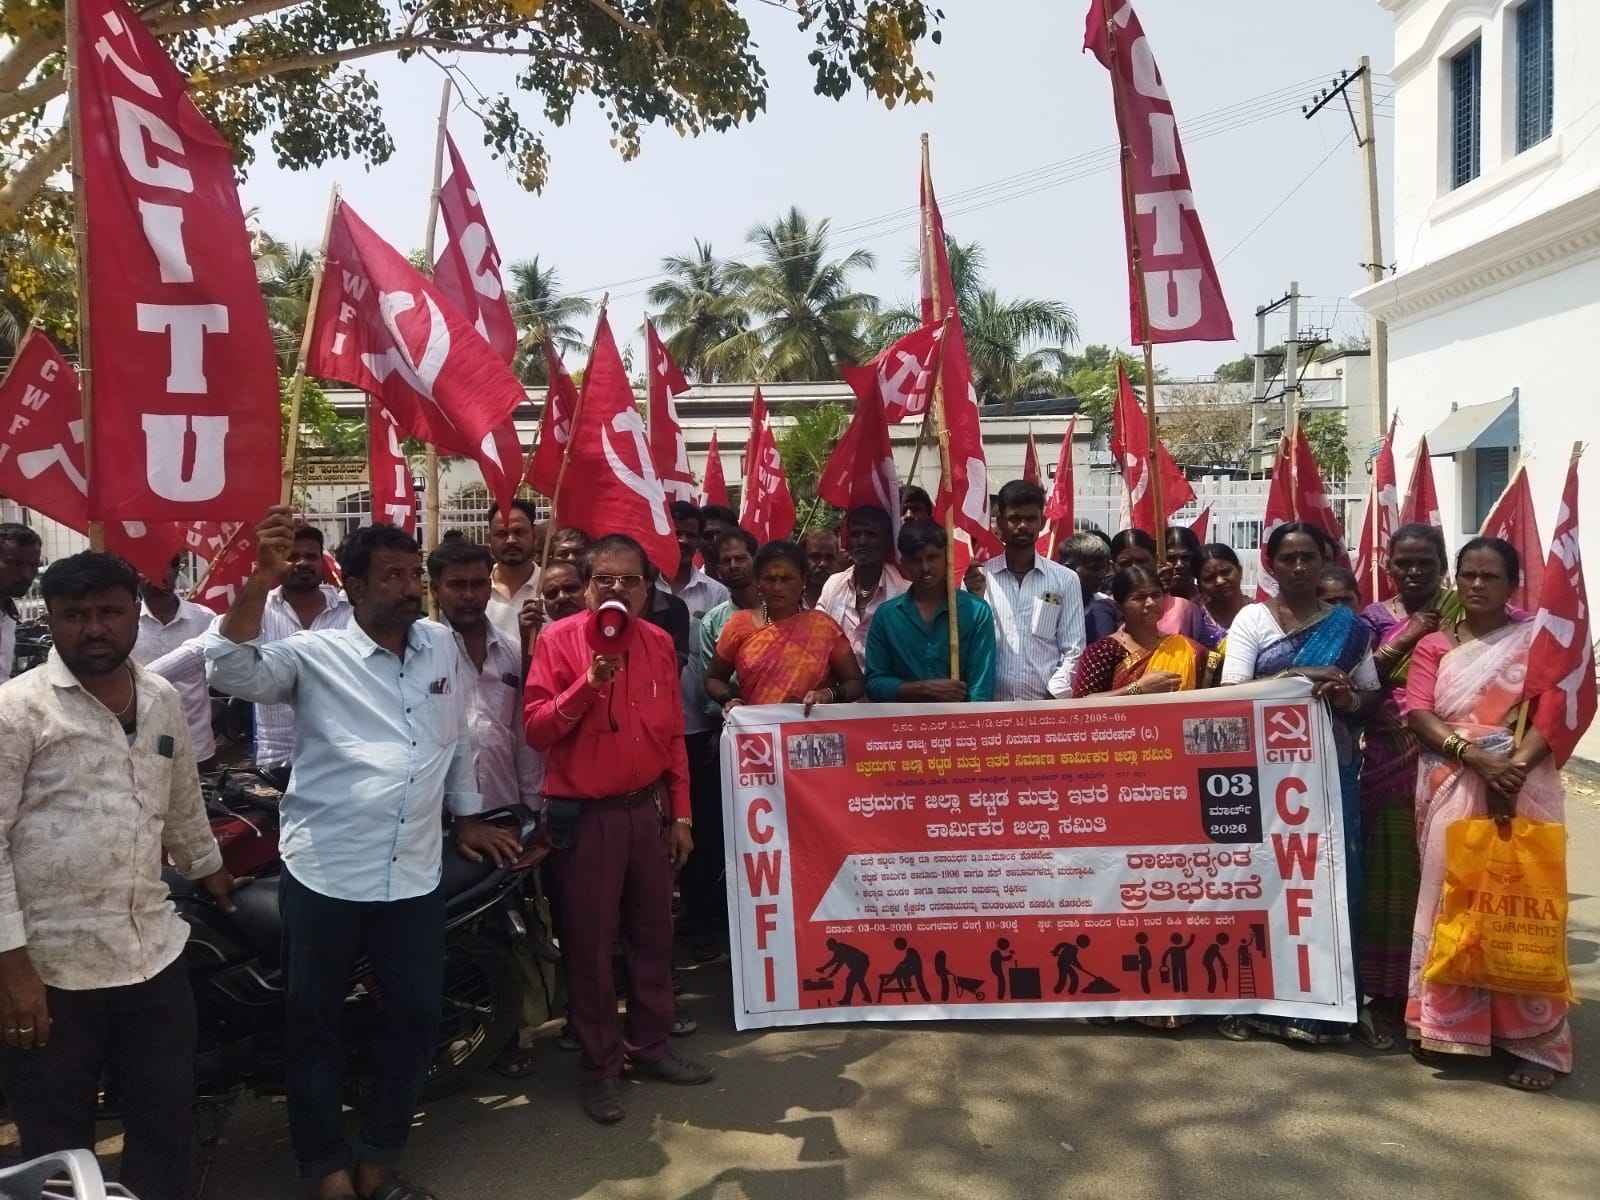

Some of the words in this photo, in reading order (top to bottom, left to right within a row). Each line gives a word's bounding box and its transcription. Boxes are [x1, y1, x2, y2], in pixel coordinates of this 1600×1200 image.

[111, 95, 230, 503] CITU
[331, 244, 370, 355] WFI
[866, 739, 903, 751] ಕರ್ನಾಟಕ
[907, 739, 928, 754] ರಾಜ್ಯ
[930, 736, 952, 754] ಕಟ್ಟಡ
[955, 736, 977, 750] ಮತ್ತು
[980, 733, 1002, 746] ಇತರೆ
[1006, 732, 1041, 745] ನಿರ್ಮಾಣ
[1045, 730, 1087, 743] ಕಾರ್ಮಿಕರ
[856, 759, 897, 777] ಚಿತ್ರದುರ್ಗ
[901, 758, 924, 774] ಜಿಲ್ಲಾ
[928, 756, 952, 776] ಕಟ್ಟಡ
[957, 755, 982, 772] ಮತ್ತು
[985, 753, 1010, 767] ಇತರೆ
[1015, 752, 1055, 766] ನಿರ್ಮಾಣ
[1060, 751, 1109, 765] ಕಾರ್ಮಿಕರ
[1114, 749, 1138, 766] ಜಿಲ್ಲಾ
[1142, 747, 1173, 761] ಸಮಿತಿ
[1265, 748, 1312, 763] CITU
[739, 773, 776, 787] CITU
[1206, 773, 1253, 797] 03
[848, 793, 916, 818] ಚಿತ್ರದುರ್ಗ
[925, 793, 961, 815] ಜಿಲ್ಲಾ
[969, 789, 1010, 816] ಕಟ್ಟಡ
[1018, 787, 1059, 811] ಮತ್ತು
[1067, 784, 1109, 805] ಇತರೆ
[1118, 782, 1188, 803] ನಿರ್ಮಾಣ
[1208, 805, 1252, 816] ಮಾರ್ಚ್
[926, 817, 1005, 838] ಕಾರ್ಮಿಕರ
[1013, 820, 1050, 841] ಜಿಲ್ಲಾ
[1058, 816, 1107, 835] ಸಮಿತಿ
[1210, 823, 1248, 834] 2026
[1126, 846, 1252, 878] ರಾಜ್ಯಾದ್ಯಂತ
[1120, 874, 1263, 910] ಪ್ರತಿಭಟನೆ
[1270, 776, 1319, 993] CWFI
[743, 797, 782, 1003] CWFI
[858, 923, 913, 933] 03-03-2026
[1492, 921, 1559, 938] GARMENTS
